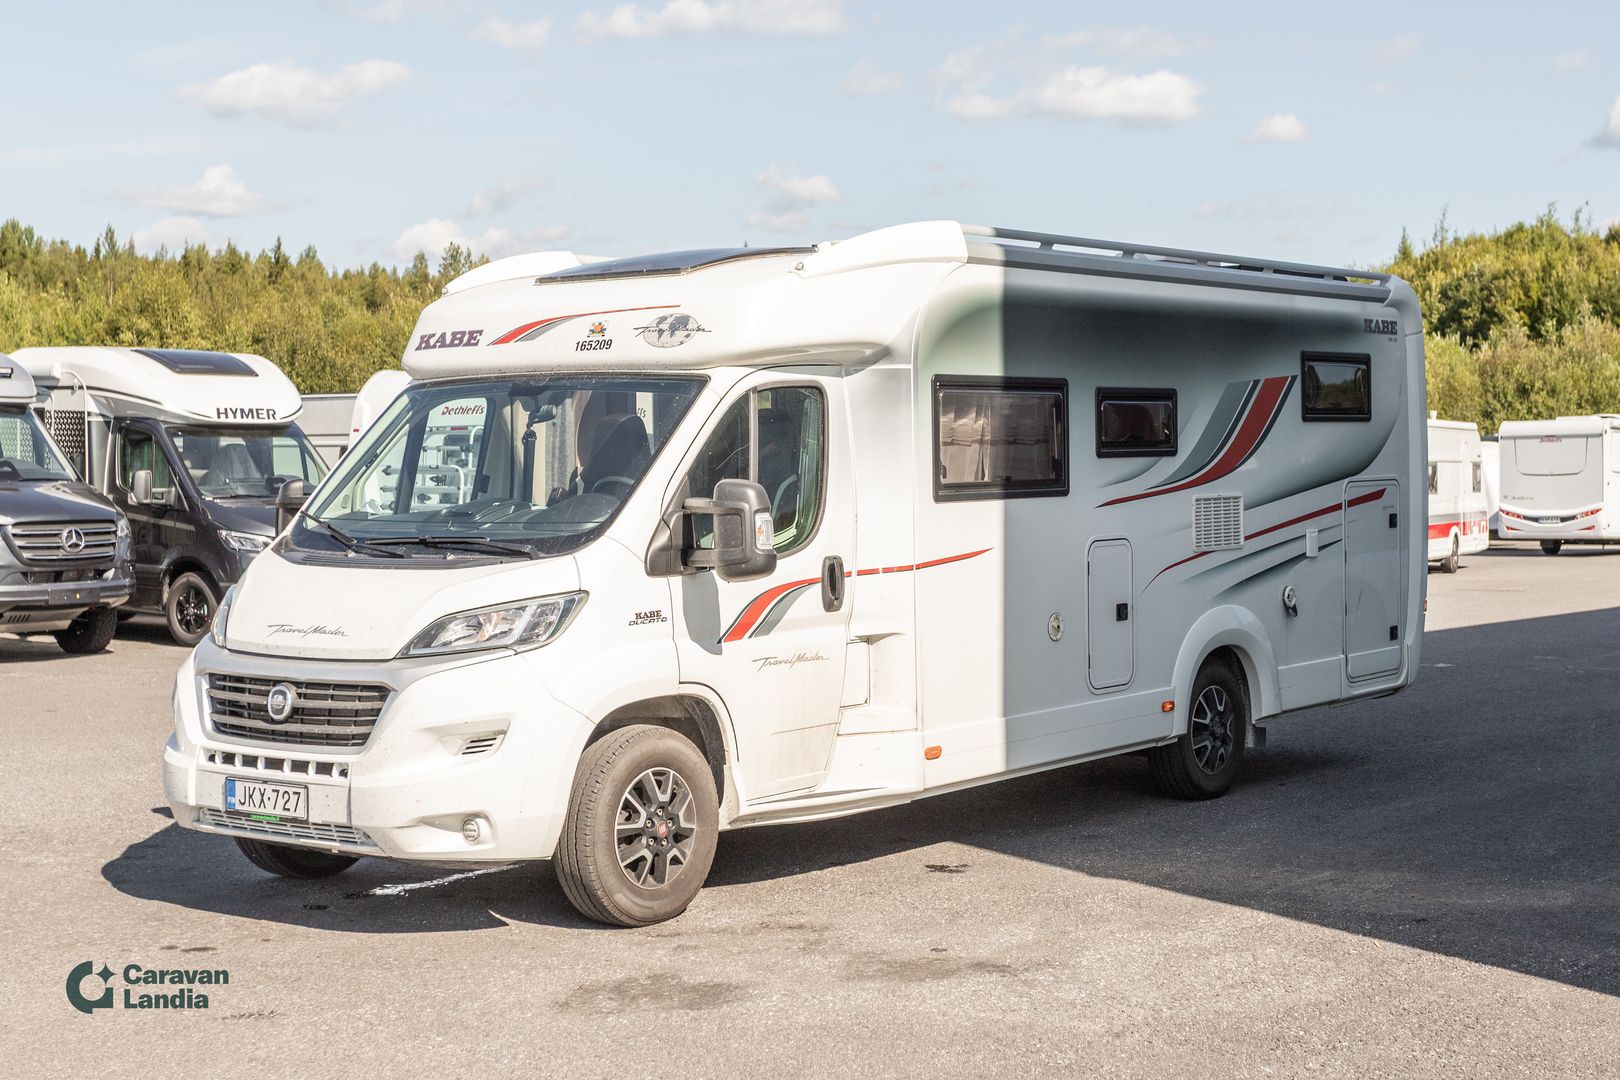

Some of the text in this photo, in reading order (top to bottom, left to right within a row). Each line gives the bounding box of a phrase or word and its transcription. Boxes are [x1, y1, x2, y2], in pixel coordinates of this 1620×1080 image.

[1363, 318, 1398, 336] KABE
[414, 329, 484, 352] KABE
[575, 339, 613, 352] 165209
[216, 407, 277, 420] HYMER
[441, 404, 486, 416] Dethleffs
[628, 616, 668, 626] DUCATO
[635, 609, 662, 620] KABE
